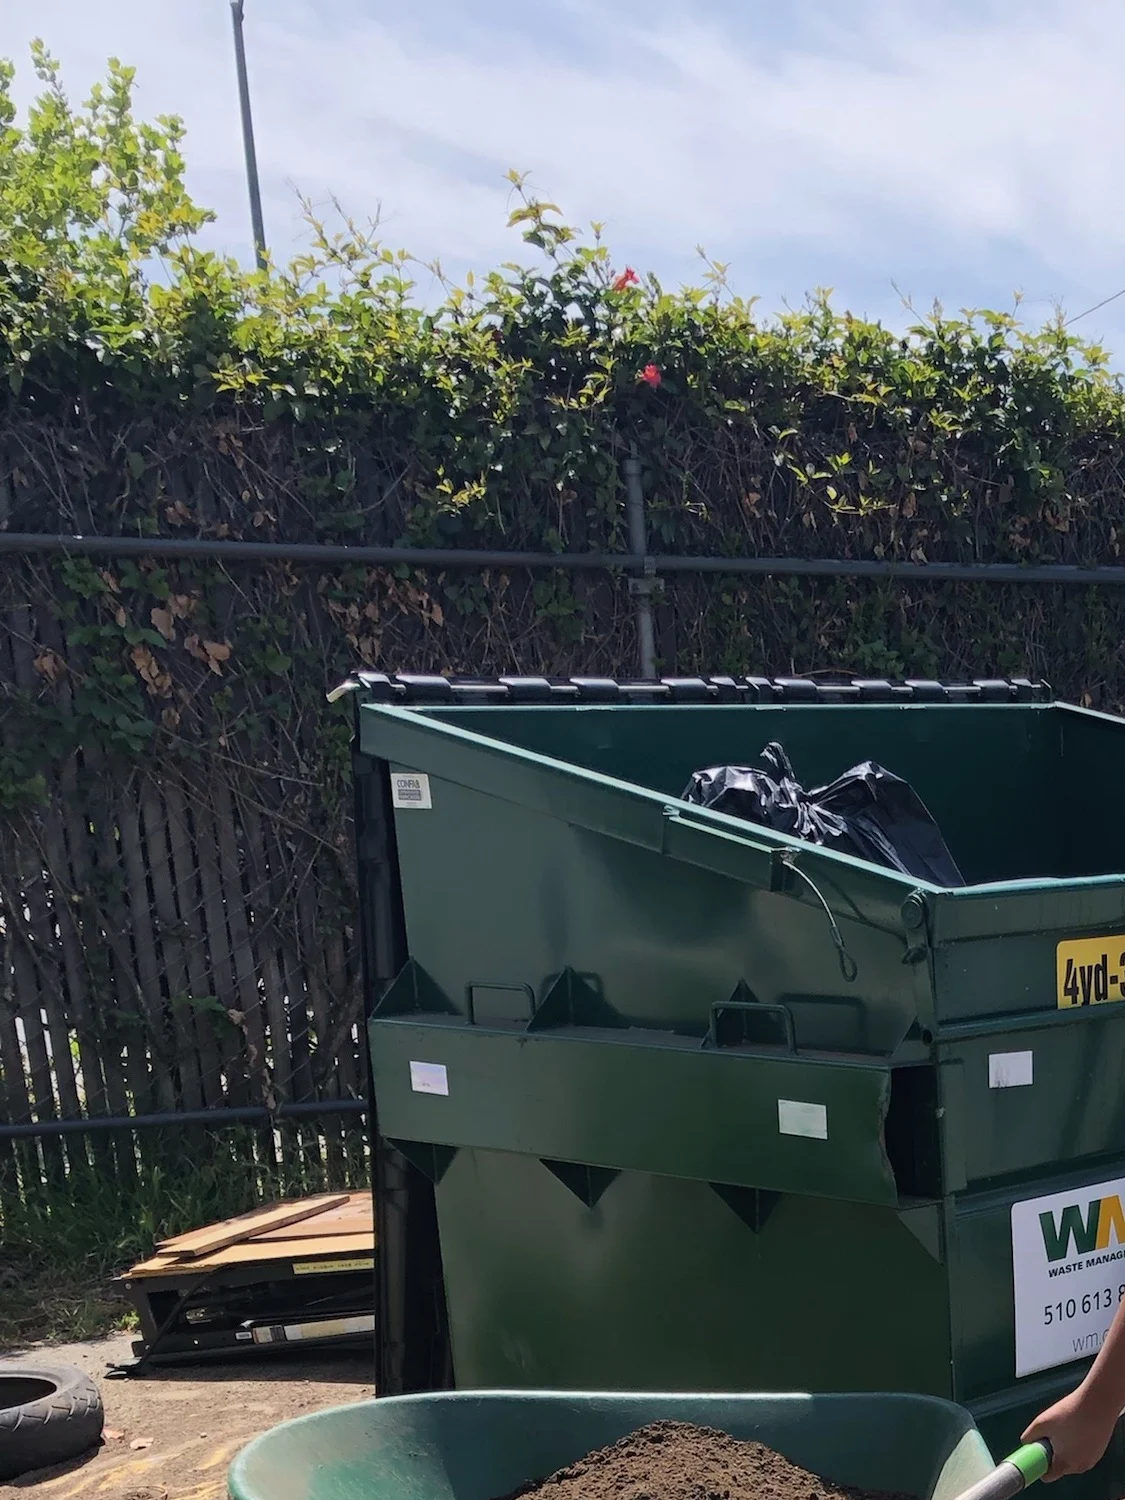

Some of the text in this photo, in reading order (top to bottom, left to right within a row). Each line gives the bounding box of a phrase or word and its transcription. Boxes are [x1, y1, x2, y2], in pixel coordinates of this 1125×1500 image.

[1048, 1261, 1084, 1278] WASTE
[1043, 1298, 1077, 1326] 510
[1081, 1288, 1112, 1314] 613
